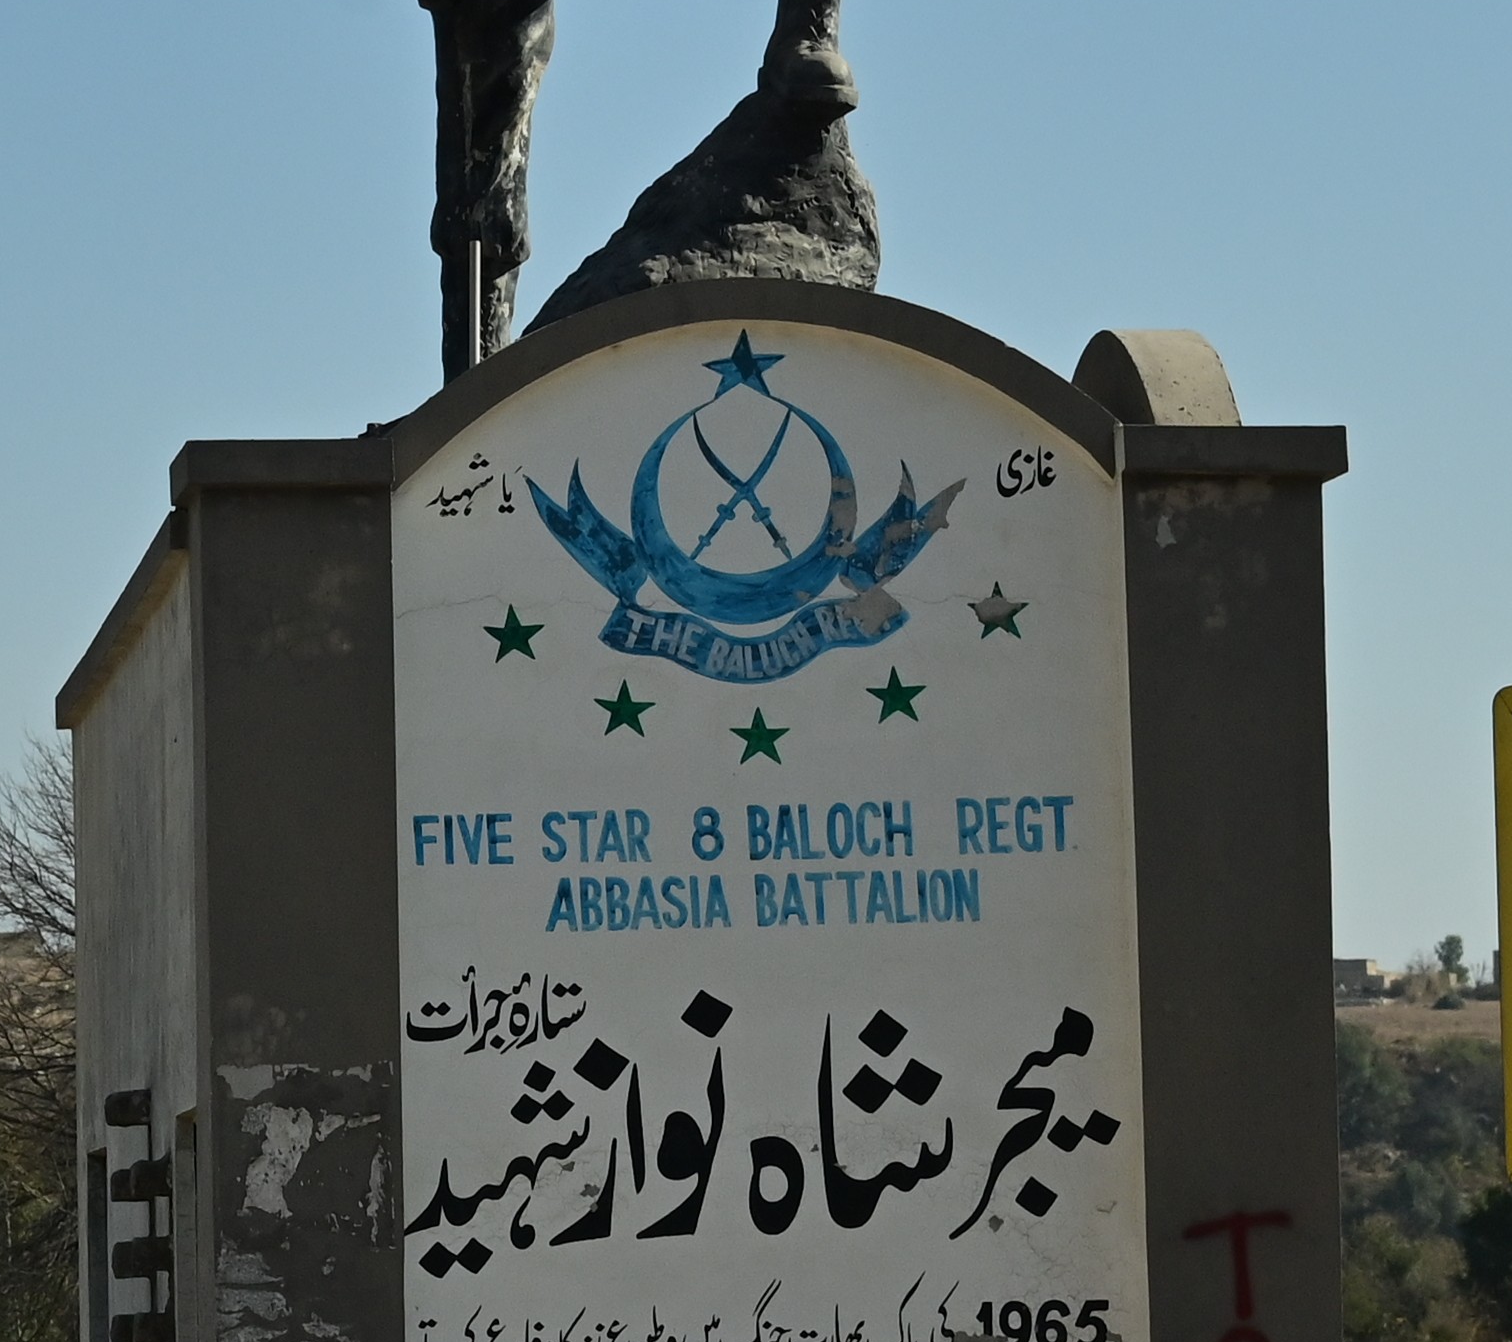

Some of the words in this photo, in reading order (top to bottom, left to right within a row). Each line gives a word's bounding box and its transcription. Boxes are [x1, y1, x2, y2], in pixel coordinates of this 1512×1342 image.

[425, 452, 494, 517] شہید
[996, 445, 1057, 498] غازی
[624, 609, 707, 663] THE
[707, 620, 816, 679] BALUCH
[413, 813, 514, 866] FIVE
[541, 808, 652, 863] STAR
[691, 806, 724, 861] 8
[746, 801, 913, 861] BALOCH
[956, 795, 1074, 854] REGT
[545, 875, 732, 932] ABBASIA
[754, 868, 980, 927] BATTALION
[549, 989, 733, 1247] نواز
[748, 1009, 954, 1235] شاہ
[948, 1006, 1121, 1241] میجر
[403, 1060, 590, 1279] شہید
